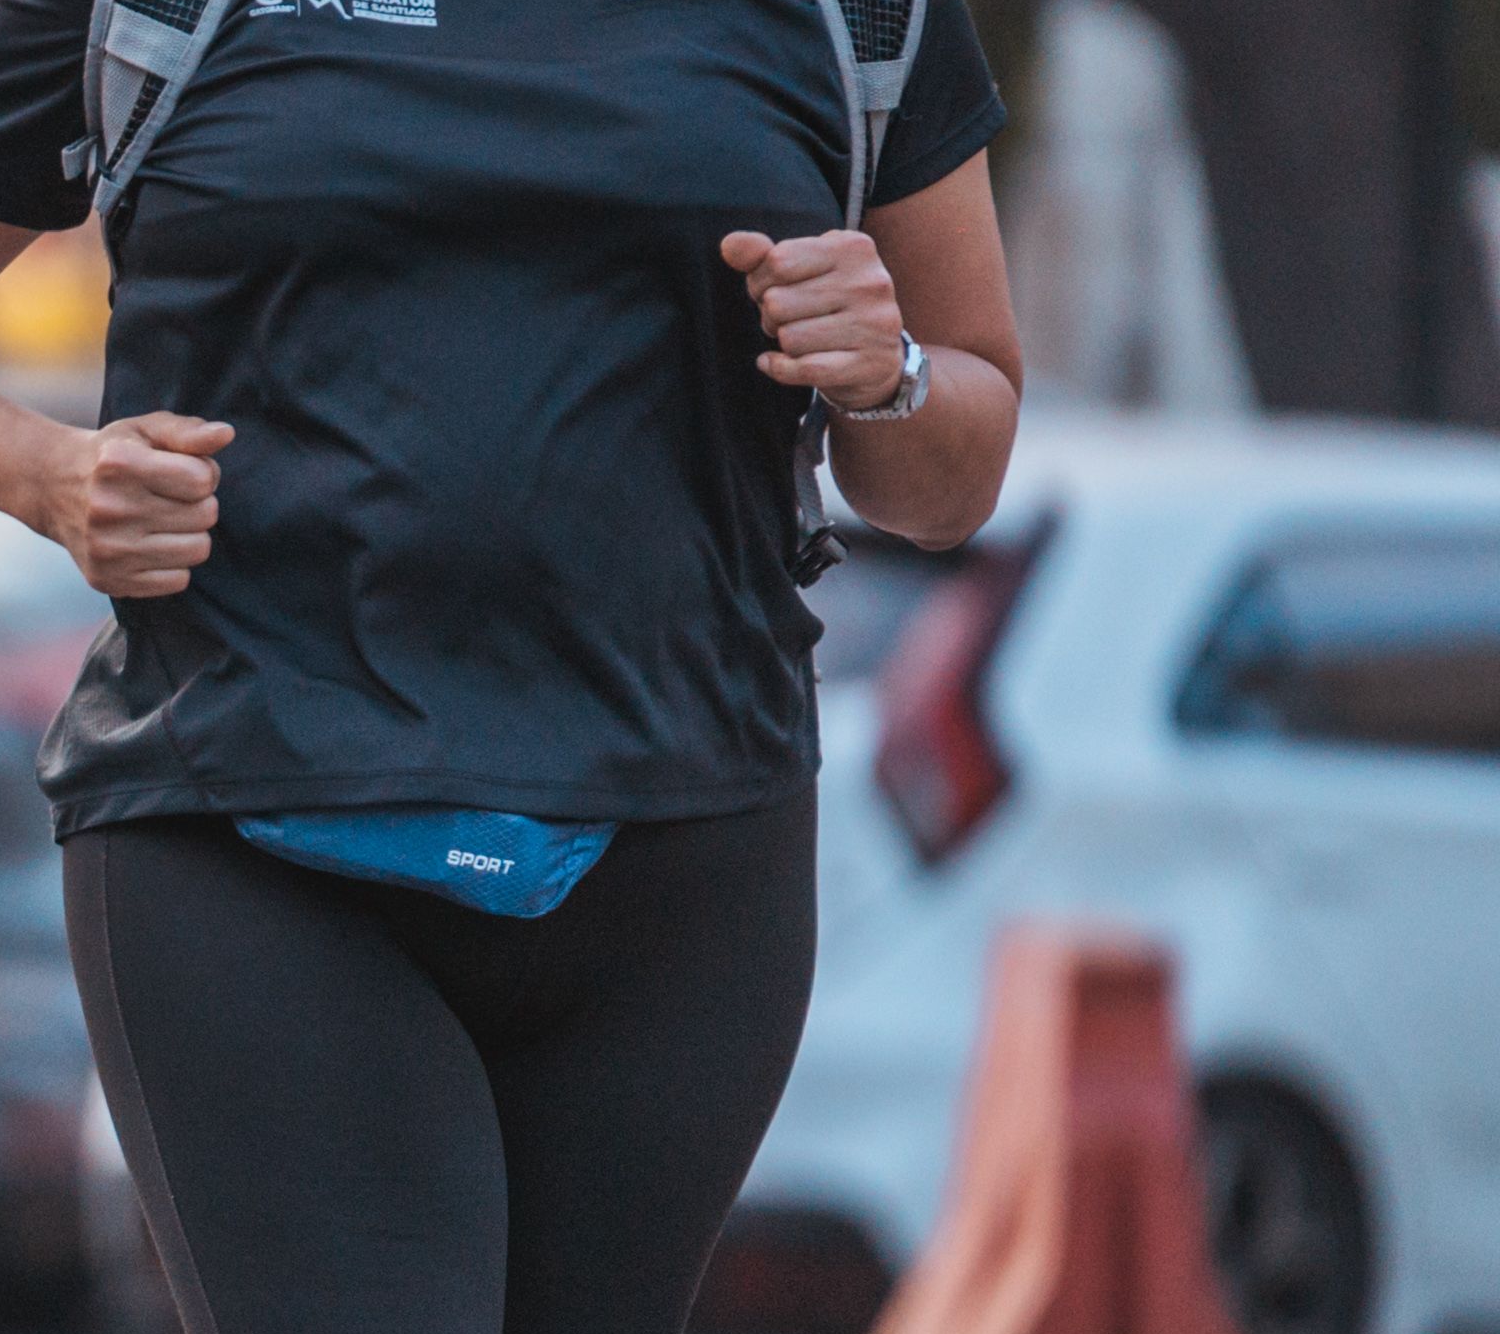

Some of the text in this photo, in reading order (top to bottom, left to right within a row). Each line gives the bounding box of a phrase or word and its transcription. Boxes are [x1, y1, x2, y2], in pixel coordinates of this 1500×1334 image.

[352, 0, 436, 17] DE SANTIAGO
[446, 850, 515, 875] SPORT
